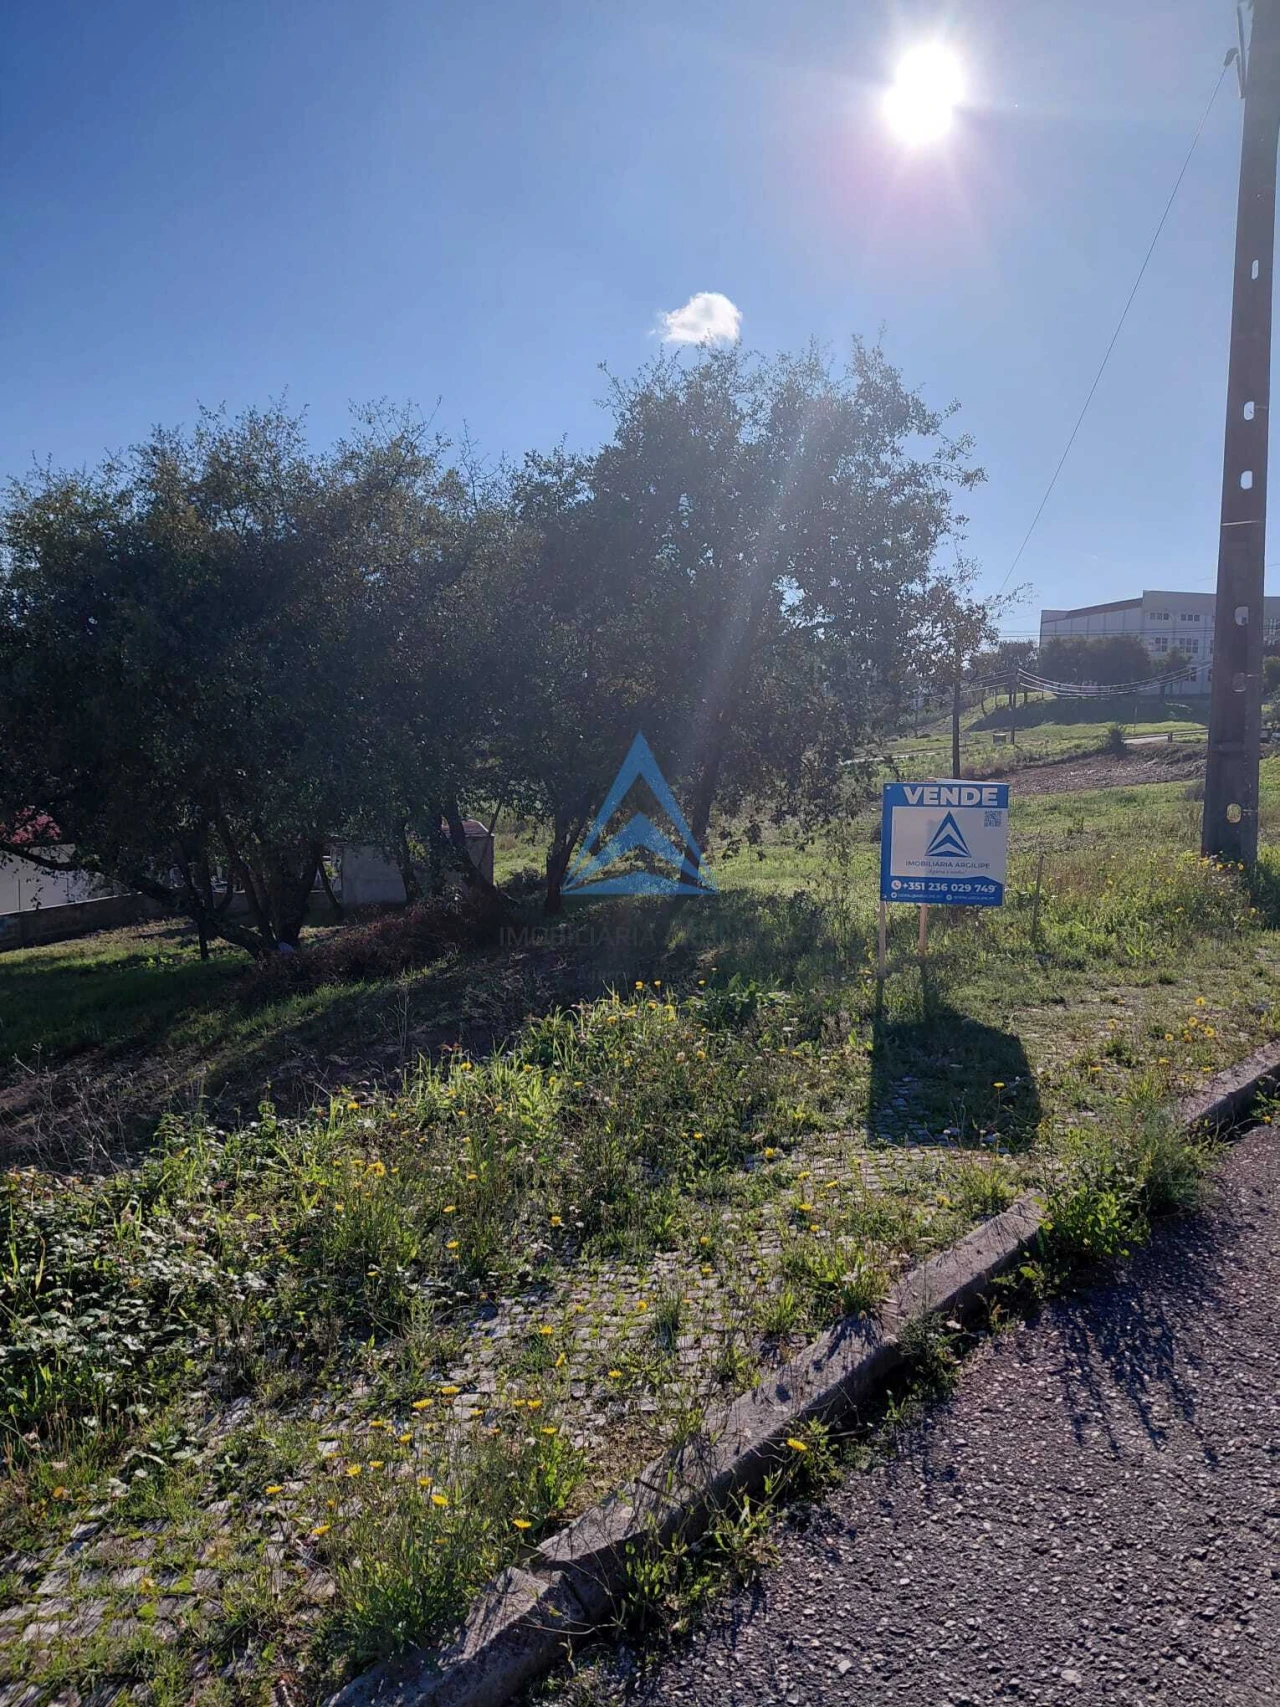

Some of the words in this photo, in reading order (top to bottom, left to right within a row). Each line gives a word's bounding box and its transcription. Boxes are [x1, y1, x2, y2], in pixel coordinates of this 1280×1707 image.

[903, 786, 998, 806] VENDE
[902, 881, 925, 891] +351
[928, 882, 948, 892] 236
[951, 883, 972, 893] 029
[974, 884, 996, 894] 749
